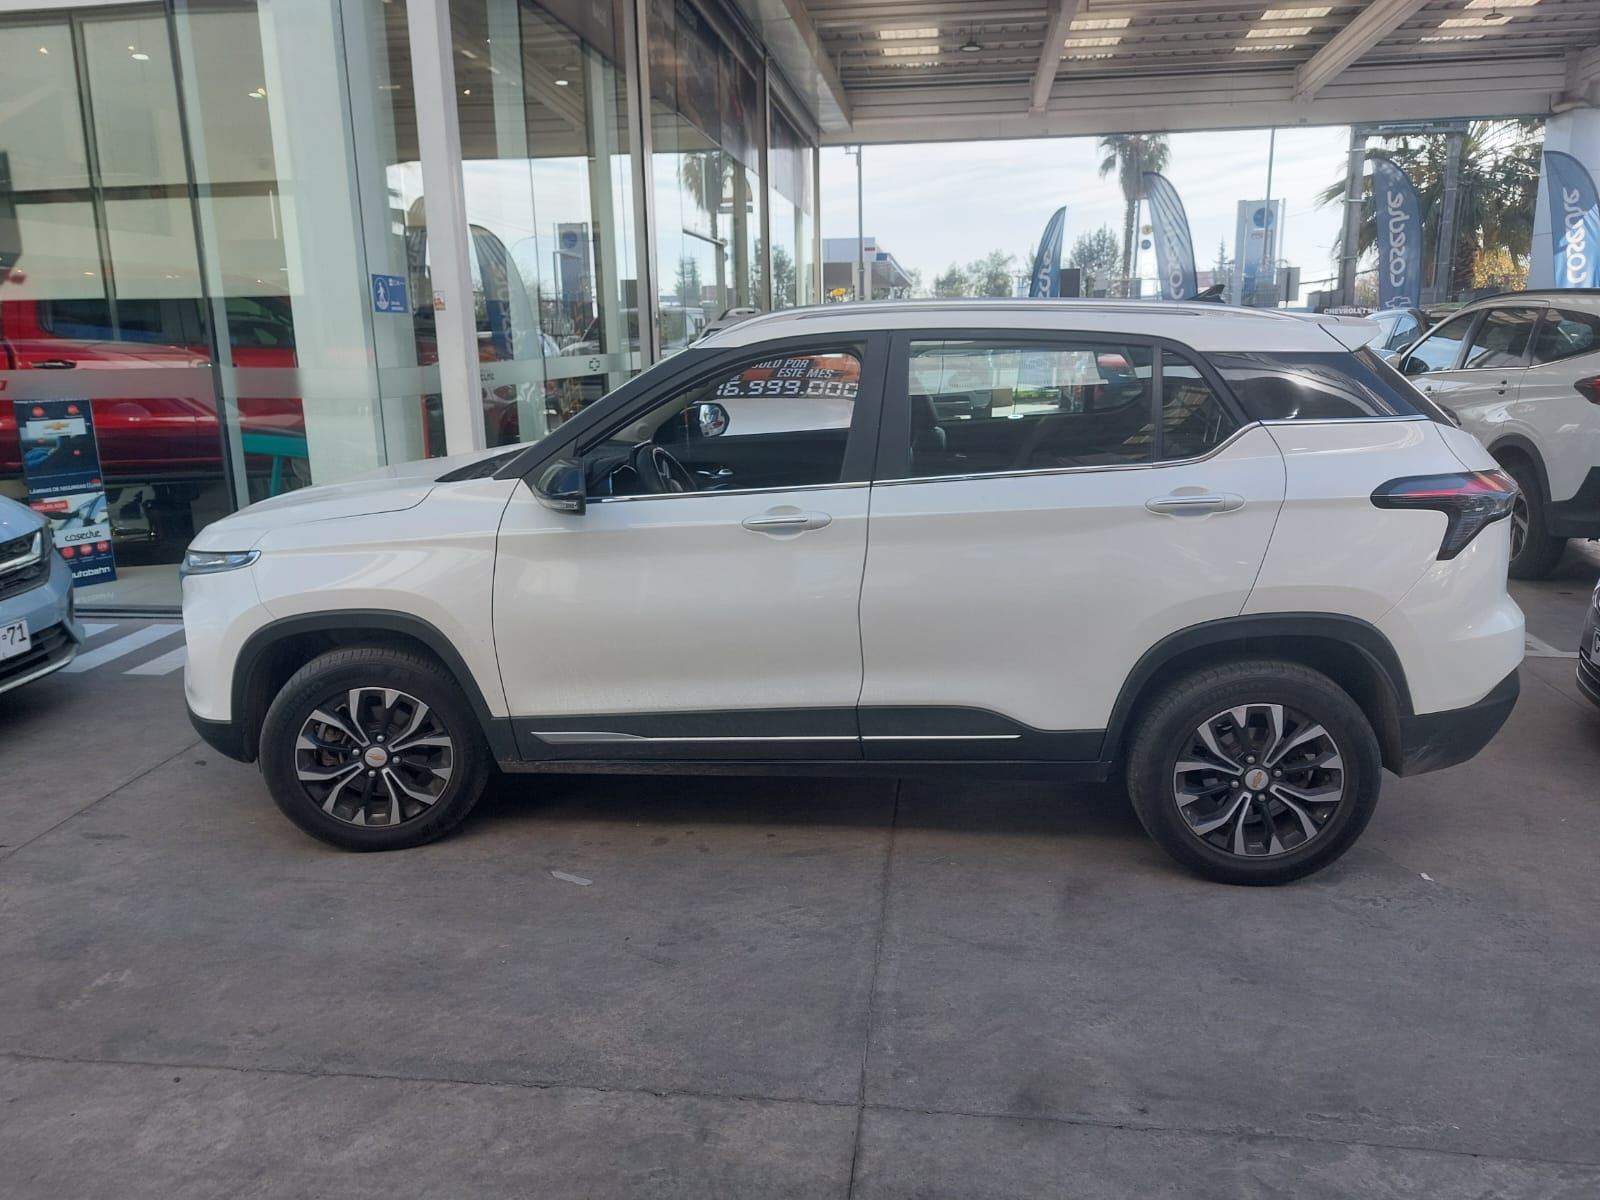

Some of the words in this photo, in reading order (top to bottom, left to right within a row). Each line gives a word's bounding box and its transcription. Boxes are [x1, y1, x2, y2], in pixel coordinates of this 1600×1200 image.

[1323, 307, 1367, 315] CHEVROLET
[783, 359, 809, 368] POR
[777, 368, 805, 378] ESTE
[806, 368, 834, 378] MES
[64, 530, 102, 542] coseche
